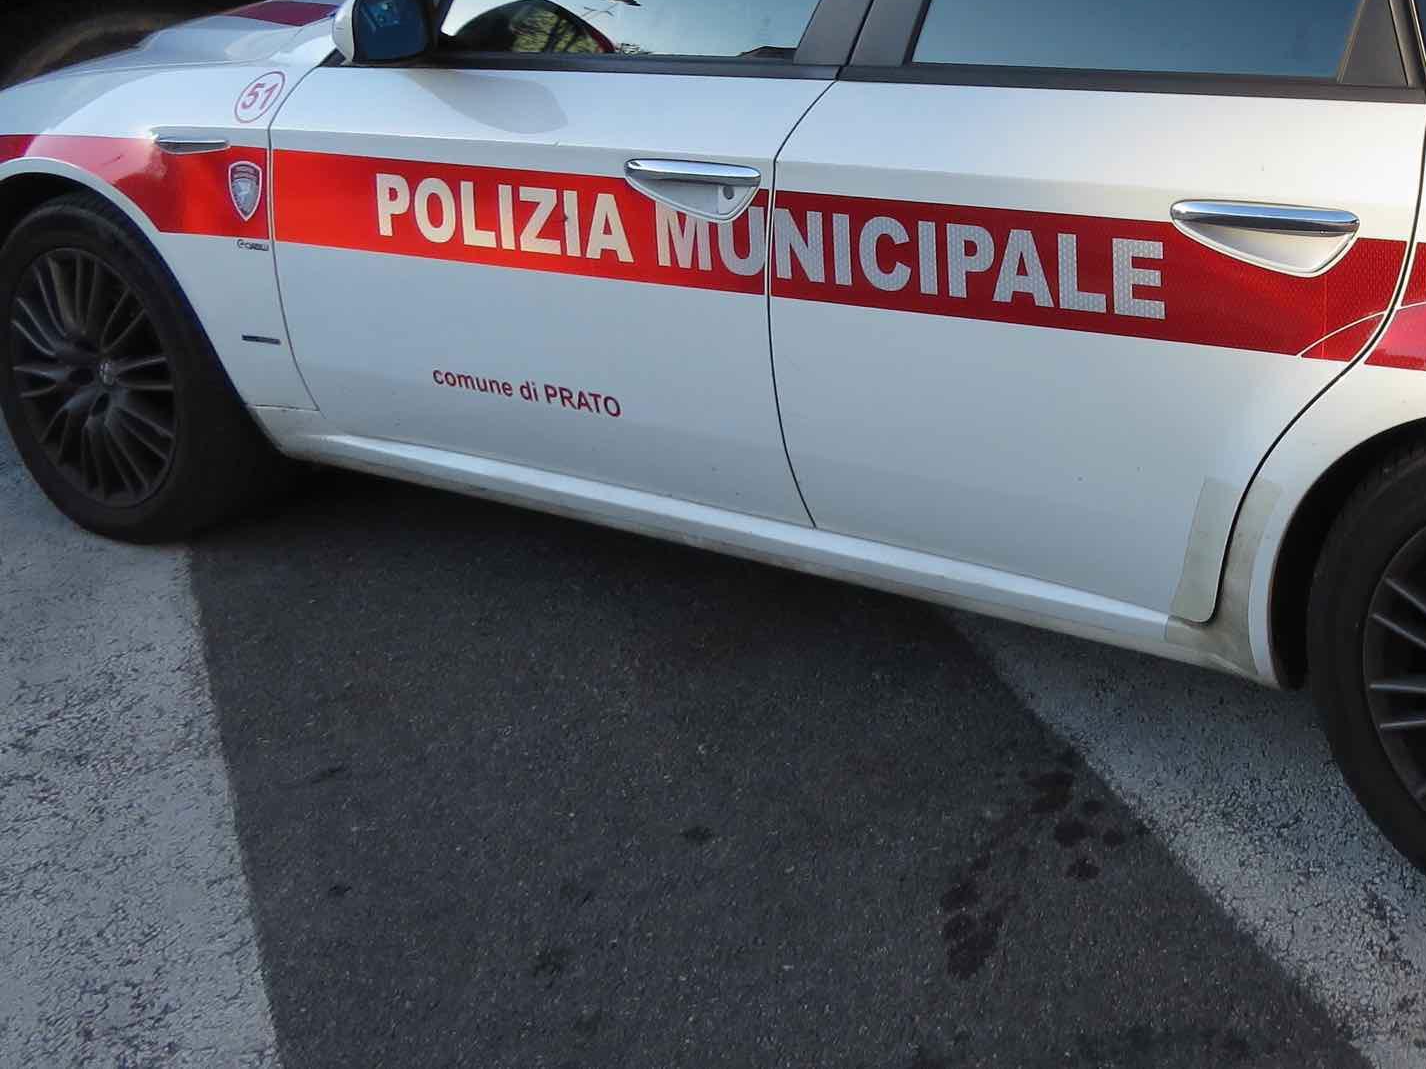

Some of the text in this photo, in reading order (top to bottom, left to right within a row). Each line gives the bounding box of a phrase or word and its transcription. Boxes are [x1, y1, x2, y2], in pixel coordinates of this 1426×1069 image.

[240, 79, 278, 113] 51
[375, 172, 1167, 321] POLIZIA MUNICIPALE
[432, 369, 622, 418] comune di PRATO
